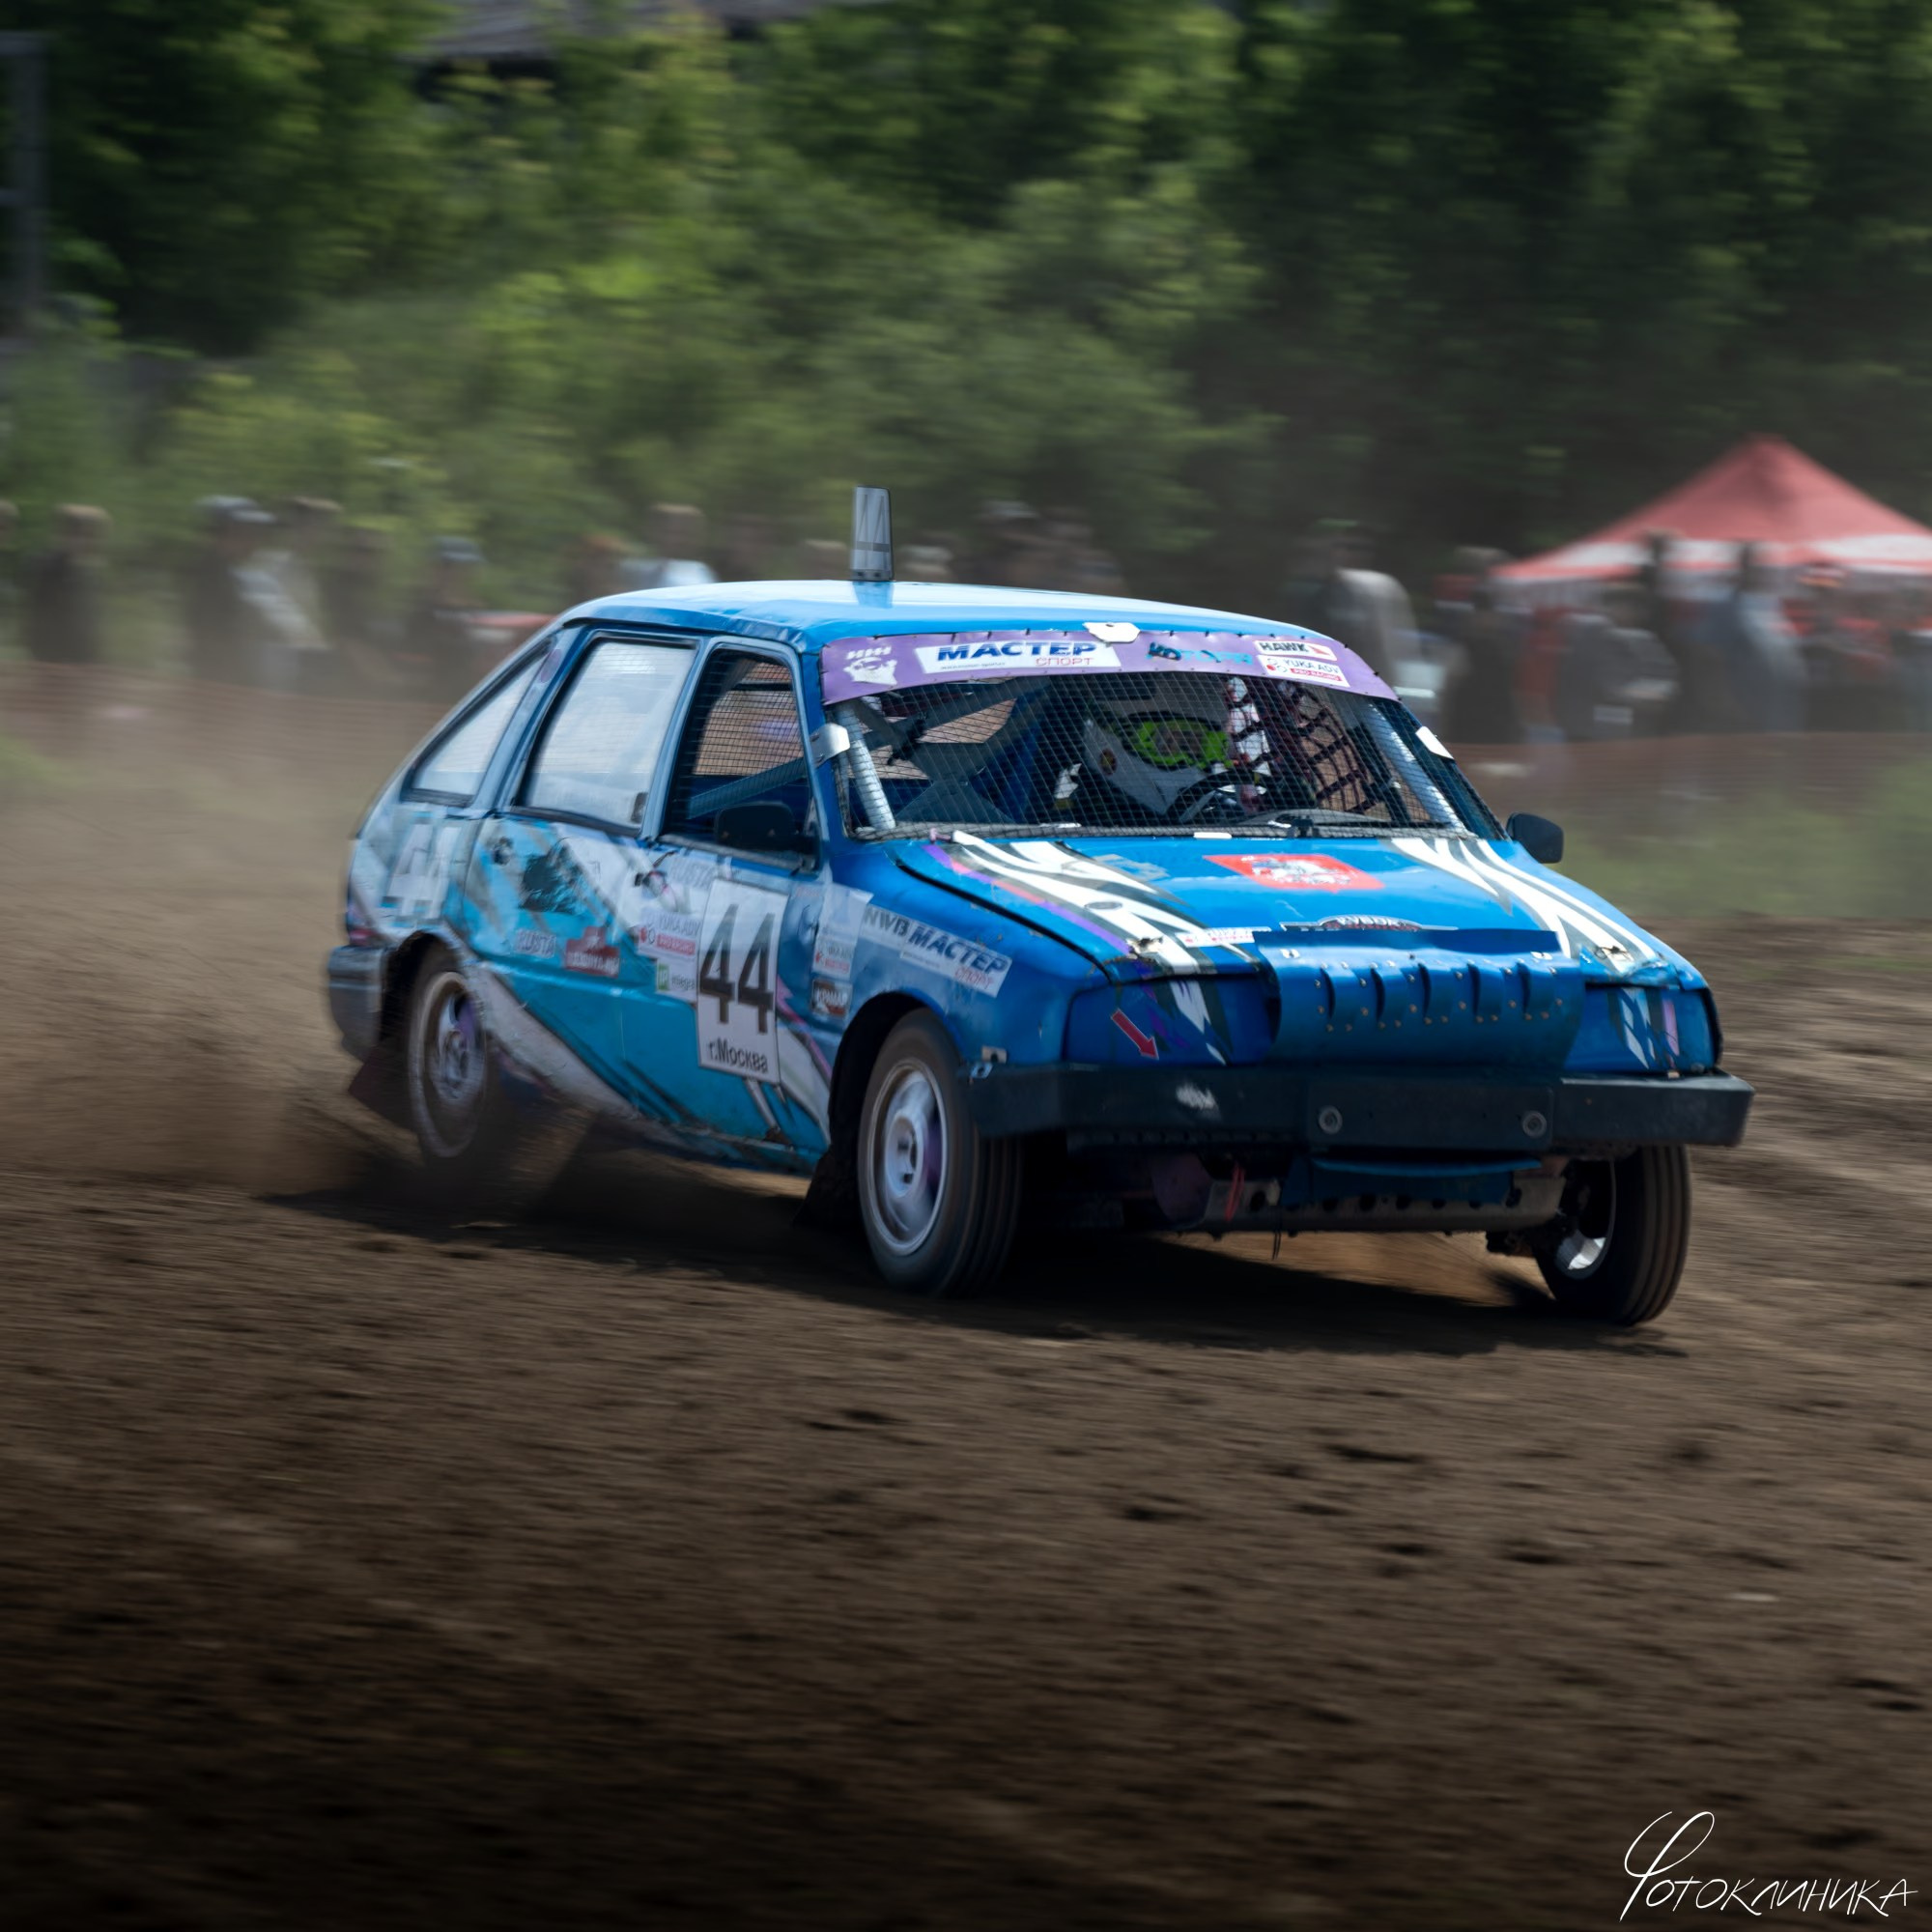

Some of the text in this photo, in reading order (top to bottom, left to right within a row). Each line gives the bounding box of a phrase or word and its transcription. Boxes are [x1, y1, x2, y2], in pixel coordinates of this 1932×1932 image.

[937, 641, 1097, 662] МАСТЕР
[1259, 641, 1309, 652] HAWK
[1035, 657, 1094, 667] СПОРТ
[908, 924, 1009, 975] МАСТЕР
[699, 903, 776, 1036] 44
[708, 1037, 768, 1073] г.Москва
